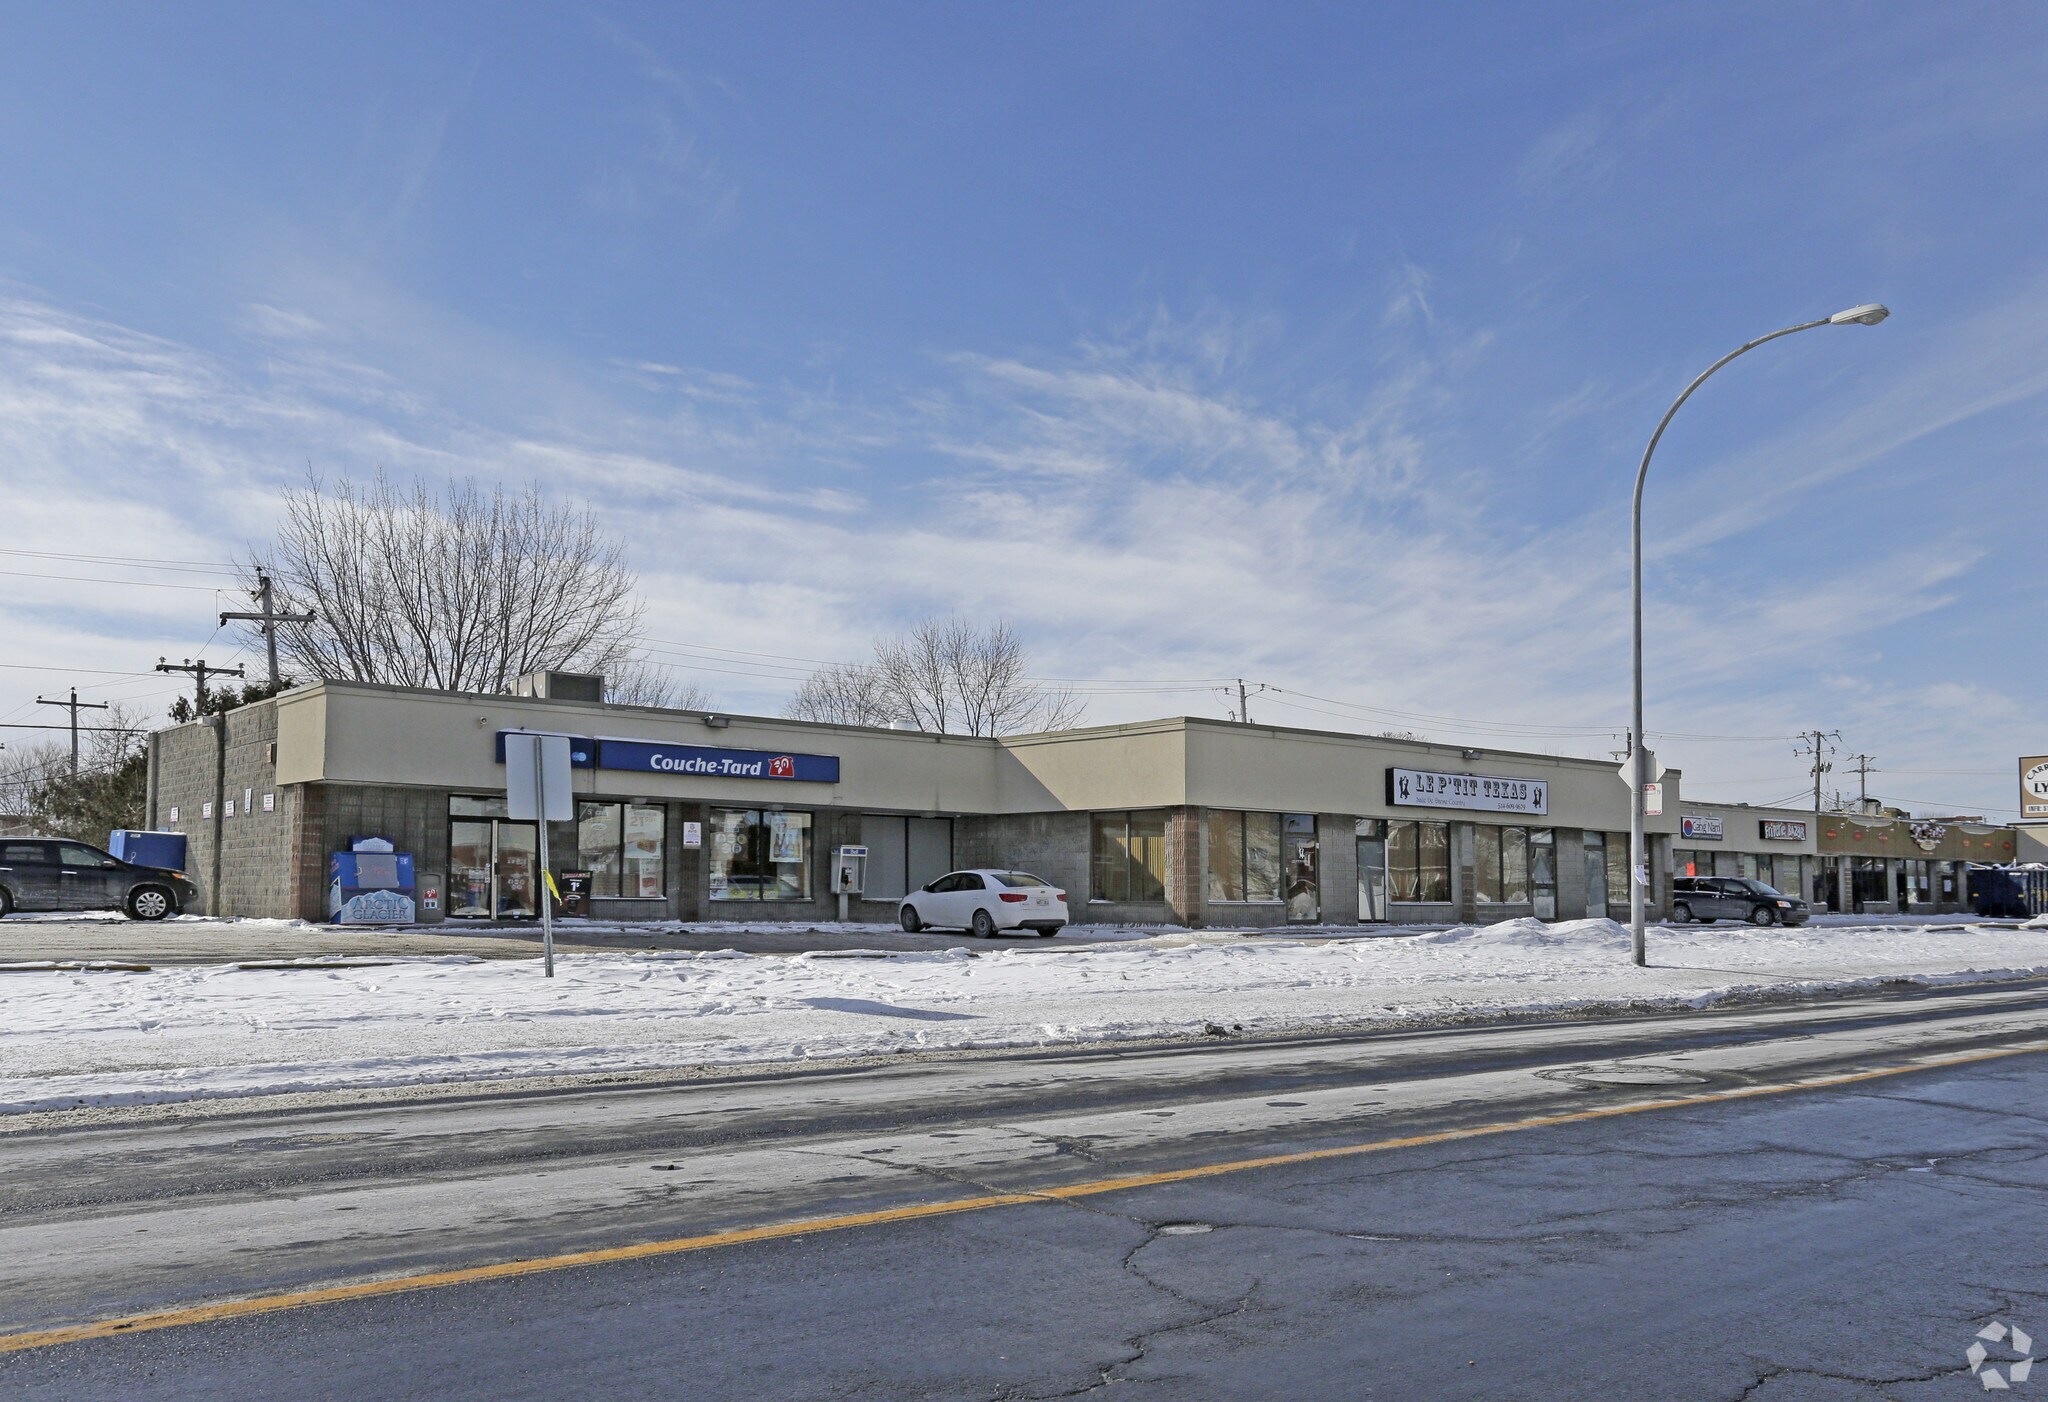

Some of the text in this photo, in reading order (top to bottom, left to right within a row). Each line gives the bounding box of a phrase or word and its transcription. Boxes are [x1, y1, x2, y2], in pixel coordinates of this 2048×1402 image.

[650, 754, 762, 775] Couche-Tard
[1416, 774, 1527, 800] LE P'TIT TEXAS
[1707, 822, 1721, 832] Nam
[353, 897, 409, 910] ARCTIC
[353, 909, 408, 920] GLACIER
